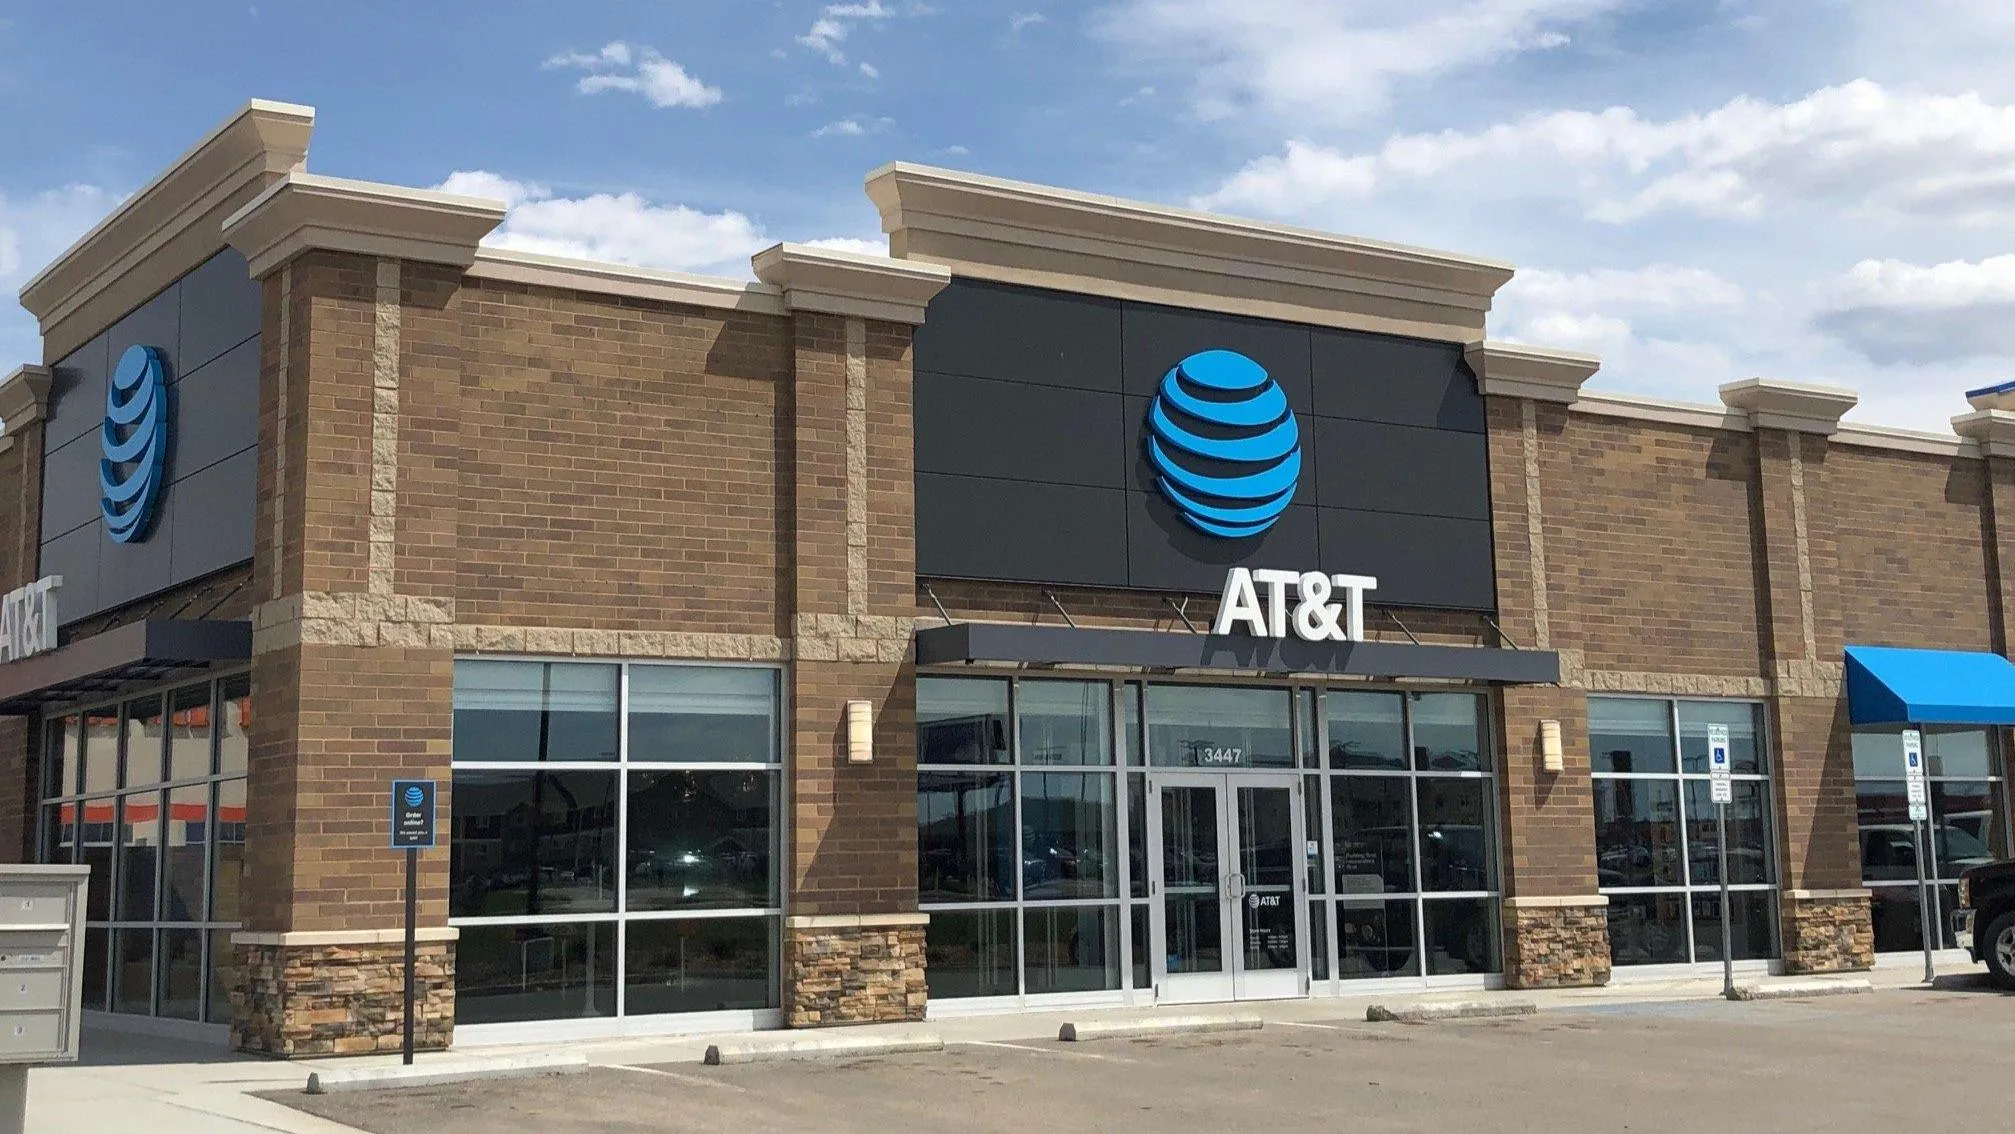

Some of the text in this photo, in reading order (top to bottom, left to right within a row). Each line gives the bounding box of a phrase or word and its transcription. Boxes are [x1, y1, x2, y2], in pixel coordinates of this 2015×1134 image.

[0, 575, 63, 664] AT&T
[1212, 567, 1377, 641] AT&T
[1204, 747, 1242, 763] 3447
[1260, 895, 1281, 906] AT&T
